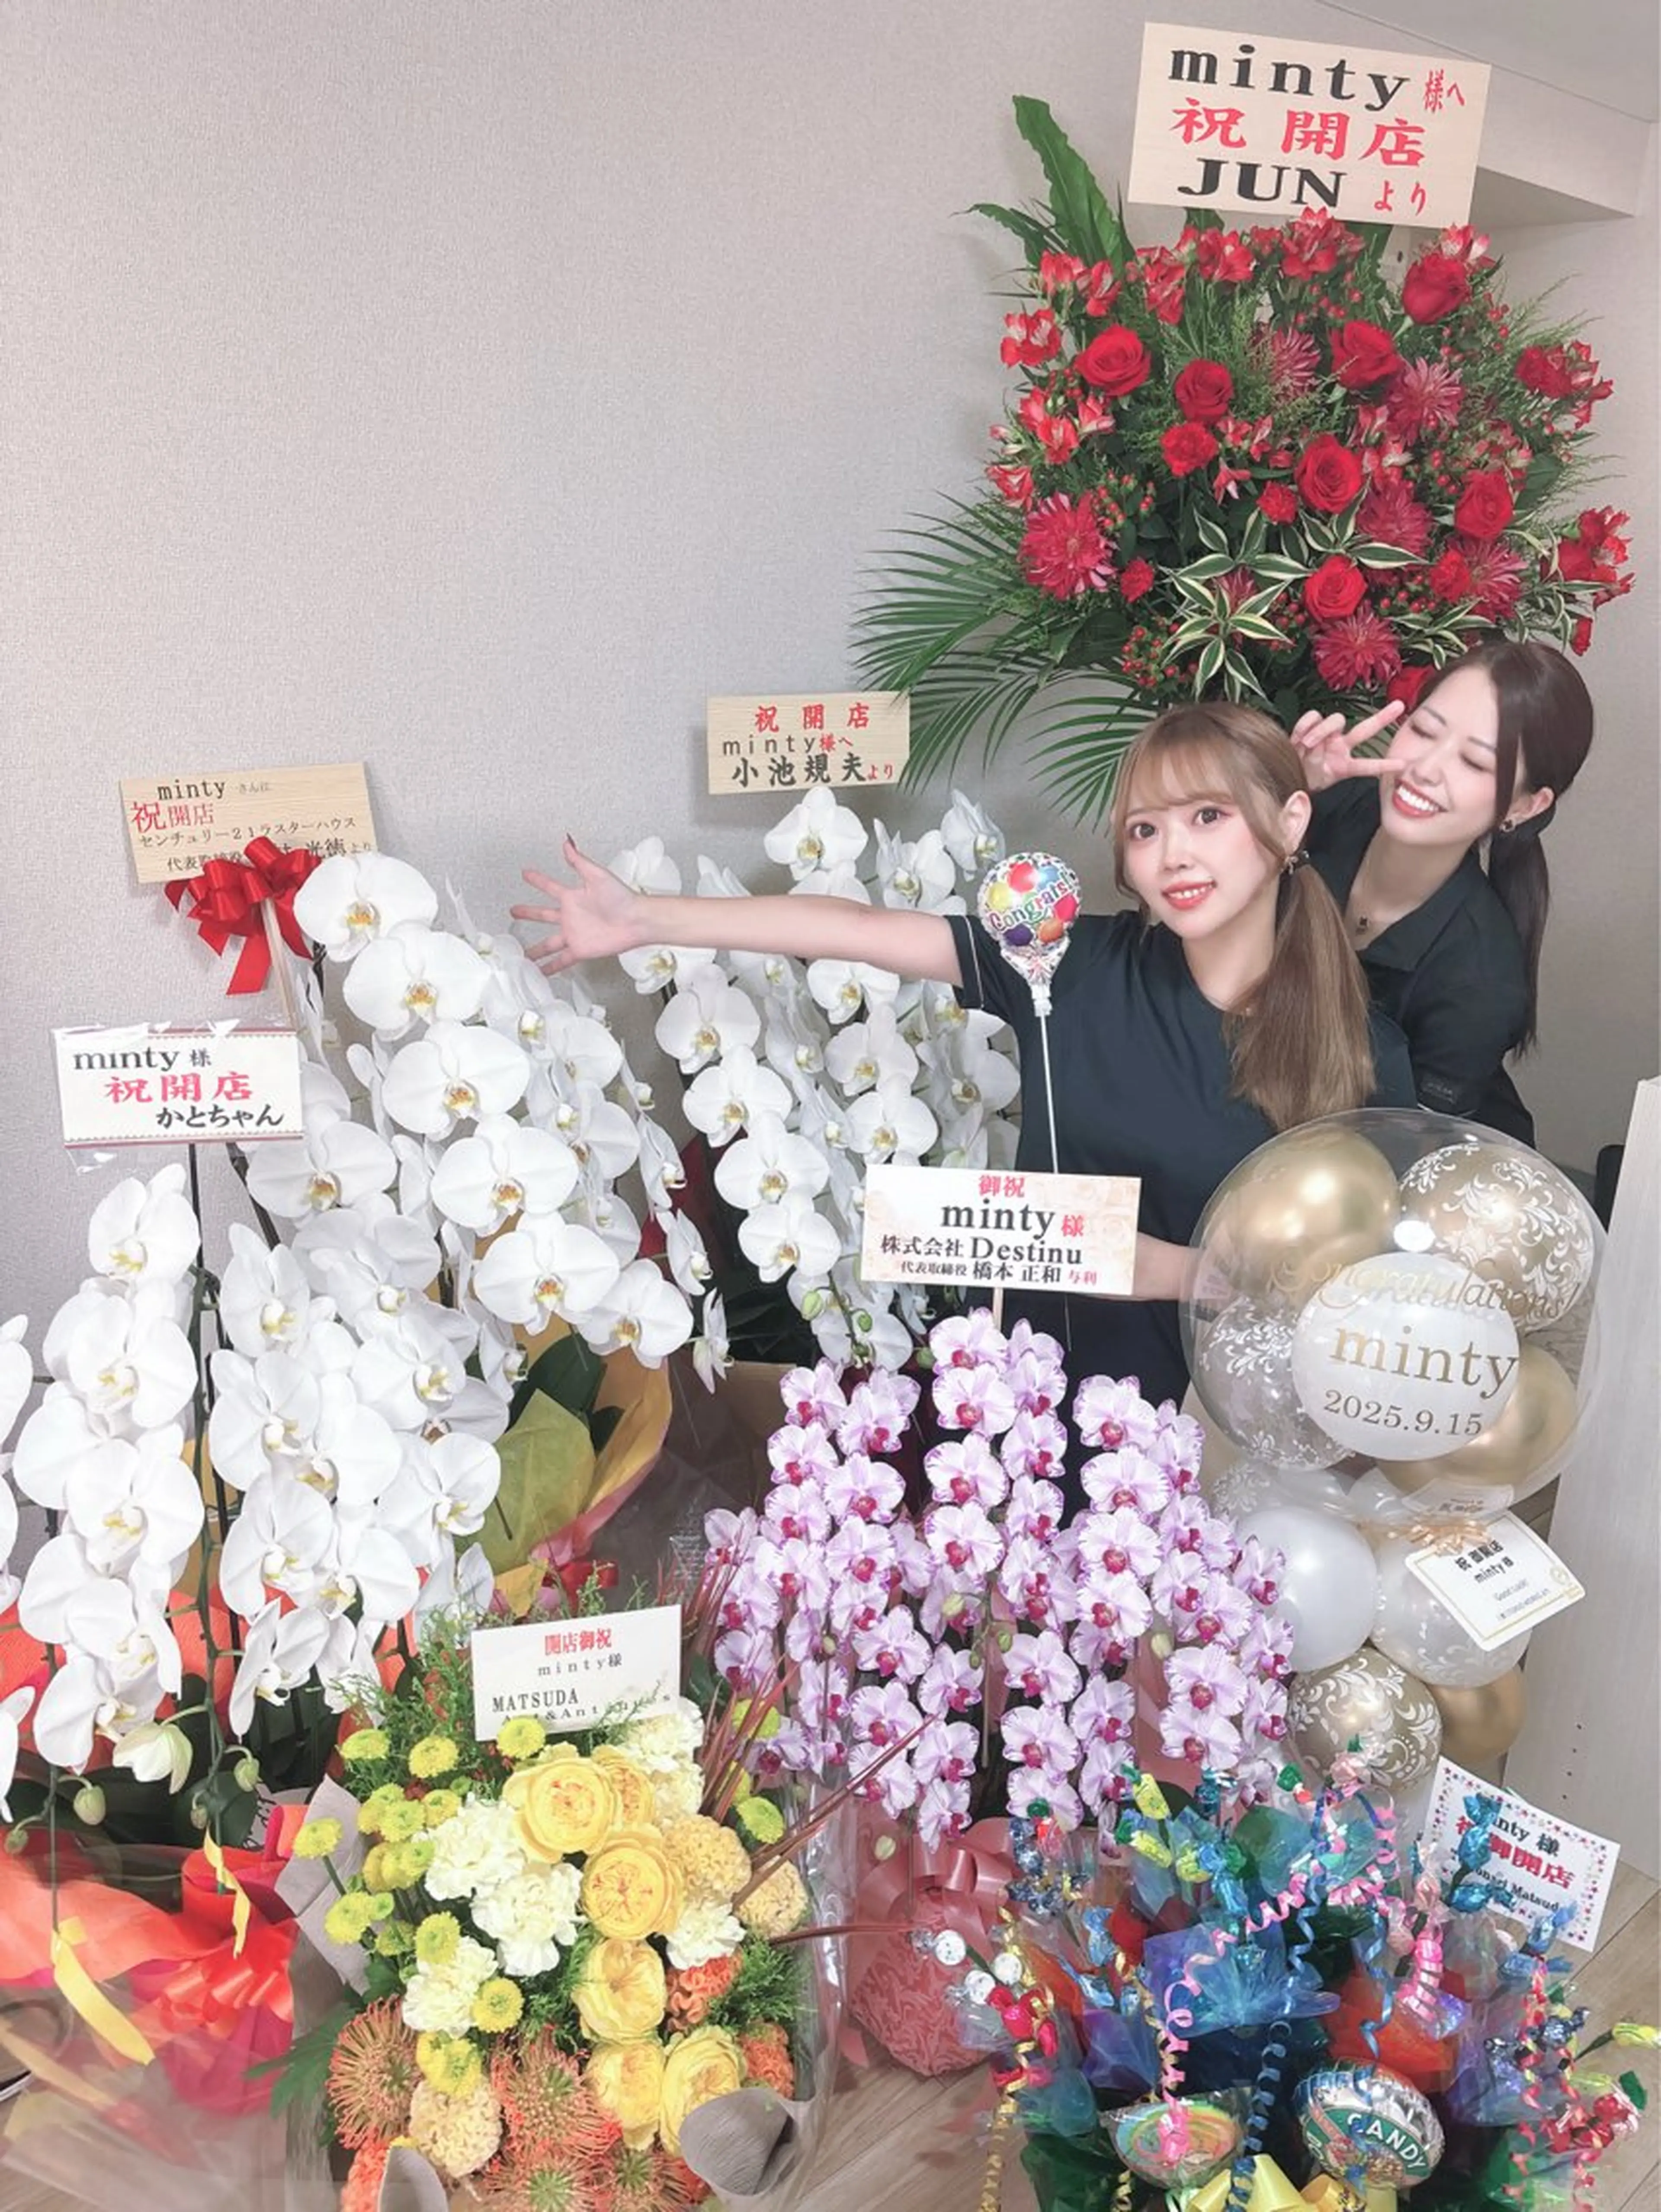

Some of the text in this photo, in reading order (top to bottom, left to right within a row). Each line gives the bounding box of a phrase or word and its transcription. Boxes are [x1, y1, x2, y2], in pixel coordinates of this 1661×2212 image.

[1168, 44, 1411, 112] minty
[1177, 157, 1427, 216] JUN より
[157, 779, 226, 801] minty
[73, 1047, 212, 1071] minty 様
[105, 1071, 253, 1103] 祝開店
[155, 1104, 285, 1128] かとちゃん
[978, 1175, 1026, 1198] 御祝
[940, 1198, 1084, 1240] minty 様
[880, 1234, 1082, 1264] 株式会社 Destinu
[1329, 1325, 1519, 1400] minty
[1324, 1390, 1483, 1436] 2025.9.15
[492, 1688, 579, 1713] MATSUDA
[1491, 1817, 1530, 1842] nty
[1512, 1883, 1560, 1911] Matsud
